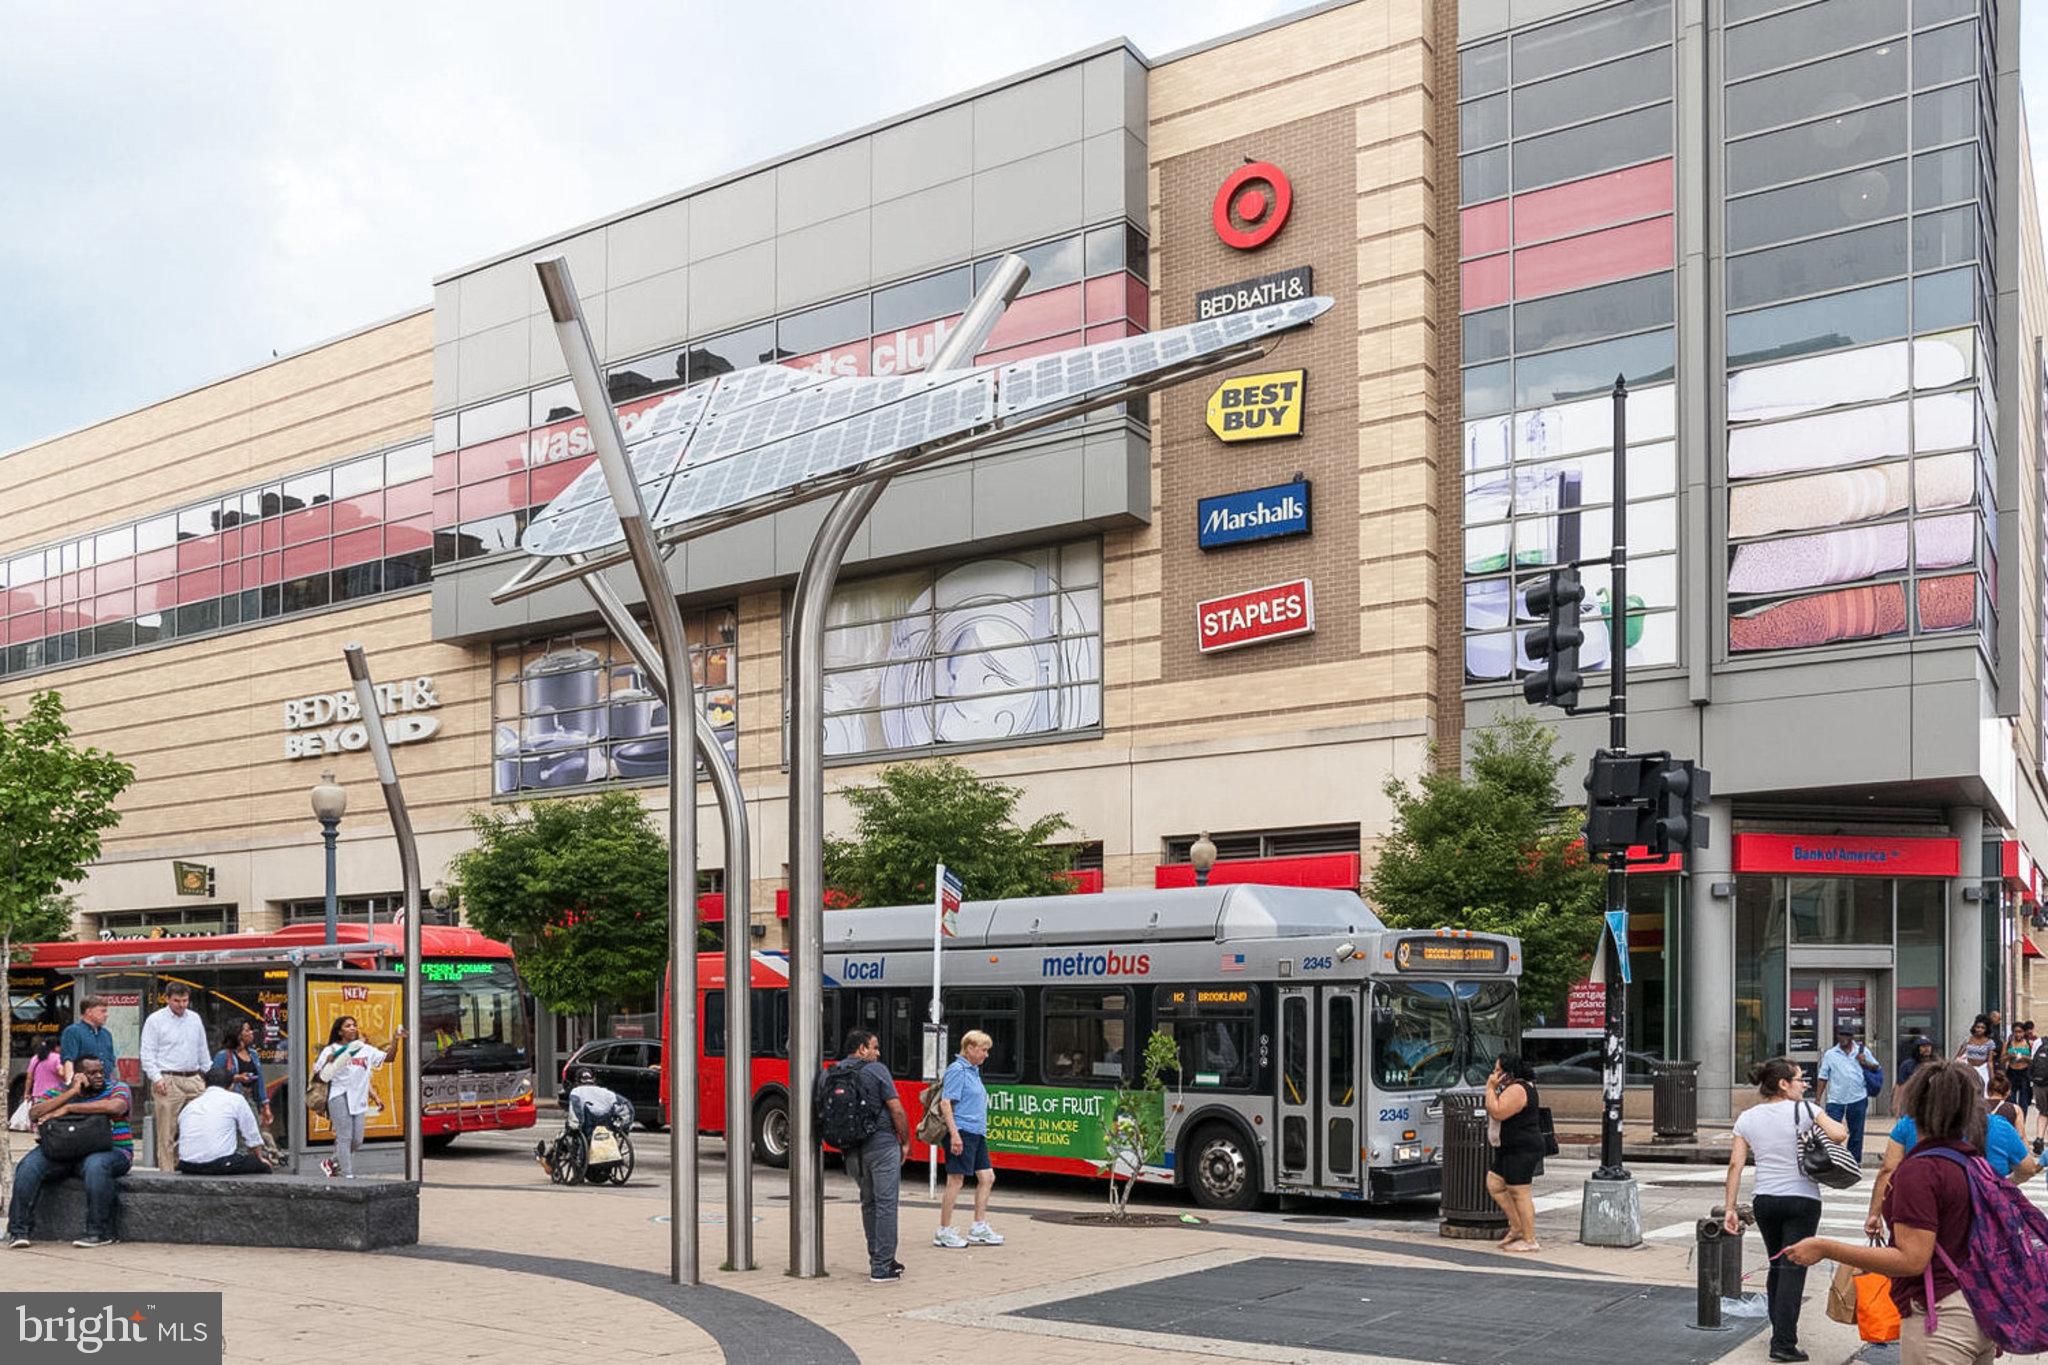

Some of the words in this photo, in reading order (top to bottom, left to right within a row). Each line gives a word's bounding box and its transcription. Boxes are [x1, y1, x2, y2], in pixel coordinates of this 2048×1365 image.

[1200, 293, 1236, 319] BED
[1237, 280, 1286, 311] BATH
[1288, 276, 1304, 298] &
[1221, 381, 1298, 409] BEST
[1223, 405, 1290, 432] BUY
[1203, 496, 1304, 535] Marshalls
[1204, 595, 1302, 636] STAPLES
[284, 694, 337, 730] BED
[336, 681, 413, 721] BTH
[413, 676, 442, 709] &
[284, 713, 442, 760] BEYOD
[1794, 846, 1823, 860] Bank
[1825, 847, 1837, 860] of
[1839, 847, 1887, 862] America
[842, 956, 886, 980] local
[1042, 949, 1151, 977] metrobus
[1303, 956, 1332, 970] 2345
[343, 986, 368, 1000] NEW
[1042, 1098, 1059, 1113] OF
[1379, 1108, 1410, 1122] 2345
[993, 1115, 1012, 1127] CAN
[1014, 1116, 1036, 1130] PACK
[1039, 1117, 1050, 1130] IN
[1051, 1120, 1079, 1133] MORE
[1007, 1130, 1034, 1143] RIDGE
[1037, 1132, 1070, 1145] HIKING
